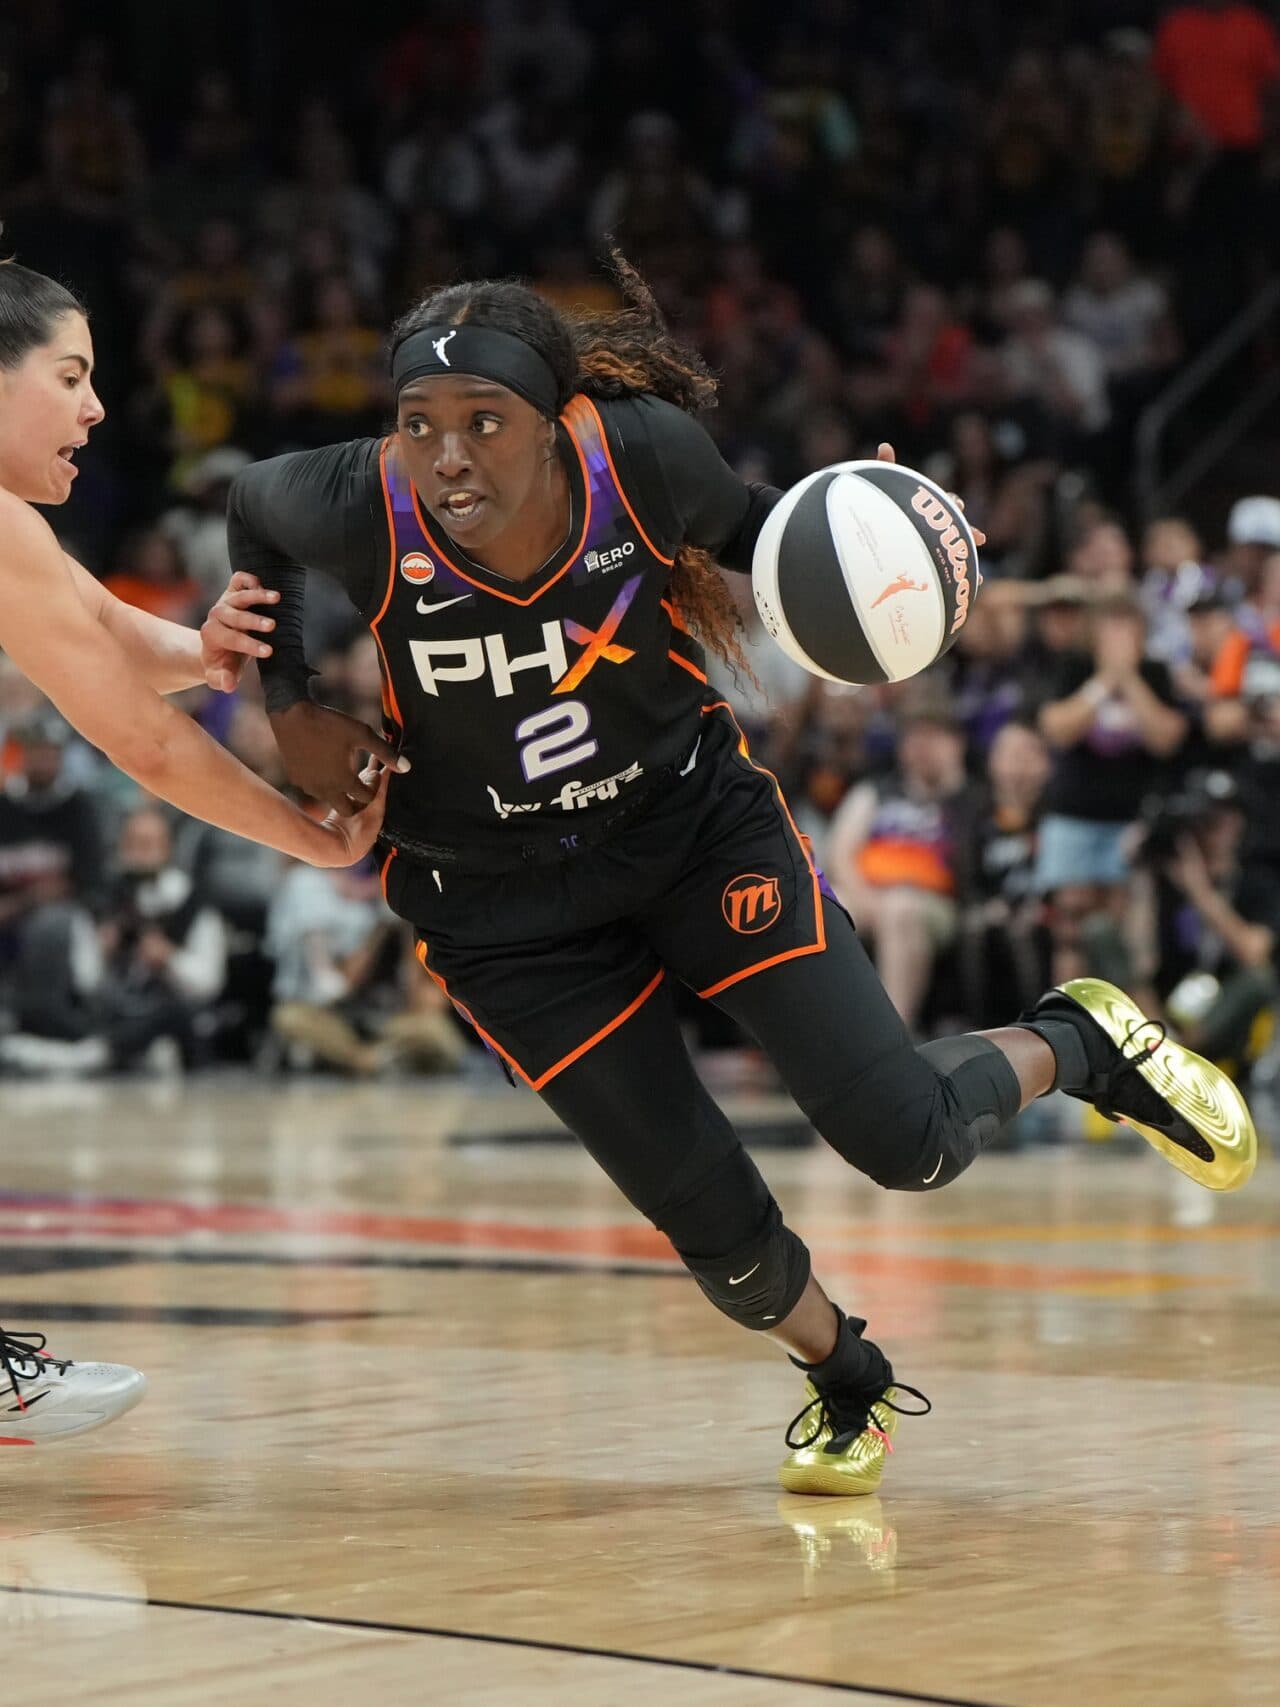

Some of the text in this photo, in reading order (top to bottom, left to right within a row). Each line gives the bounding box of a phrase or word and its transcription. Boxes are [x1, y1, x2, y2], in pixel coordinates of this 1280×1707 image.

[583, 541, 635, 573] HERO
[408, 574, 643, 698] PHX
[515, 700, 600, 784] 2
